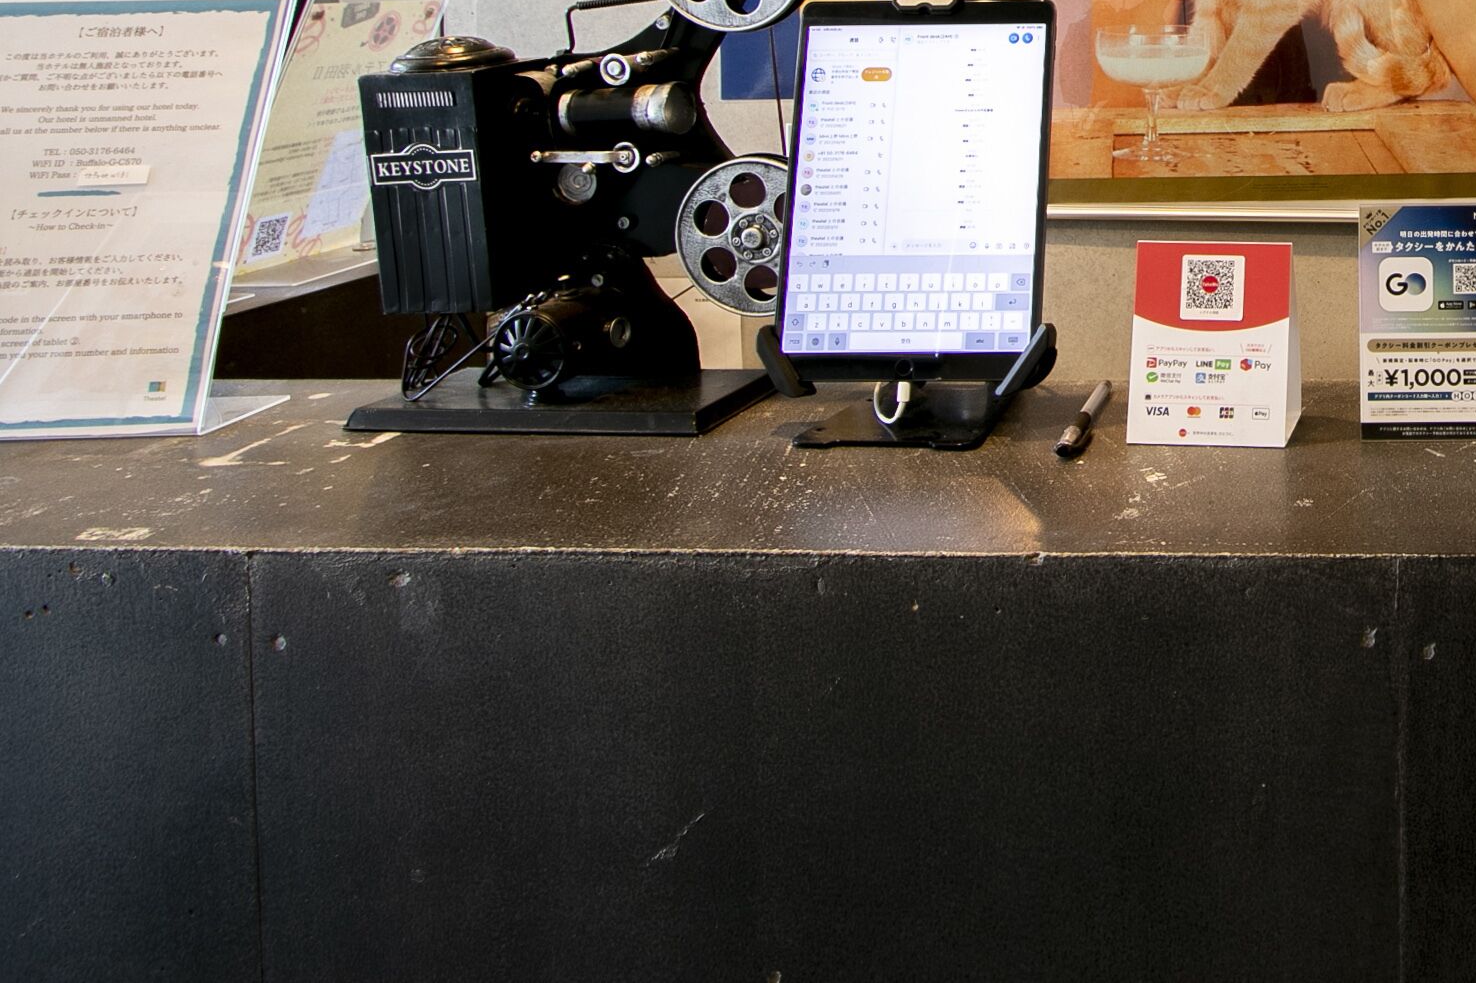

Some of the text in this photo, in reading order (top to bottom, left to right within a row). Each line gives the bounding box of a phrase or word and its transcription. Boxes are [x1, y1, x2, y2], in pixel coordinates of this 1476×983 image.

[16, 105, 53, 114] sincerely
[56, 104, 79, 112] thank
[80, 105, 97, 114] you
[98, 104, 110, 112] for
[112, 104, 134, 113] using
[152, 103, 173, 111] hotel
[175, 103, 199, 112] today.
[56, 115, 78, 123] hotel
[88, 115, 133, 123] unmanned
[34, 127, 48, 135] the
[50, 126, 82, 135] number
[84, 126, 109, 134] below
[119, 125, 140, 133] there
[151, 124, 187, 134] anything
[43, 148, 61, 156] TEL
[56, 159, 66, 167] ID
[377, 158, 471, 177] KEYSTONE
[51, 171, 71, 179] Pass
[32, 315, 46, 323] the
[48, 315, 77, 323] screen
[80, 314, 97, 322] with
[99, 314, 120, 323] your
[121, 312, 172, 321] smartphone
[32, 339, 43, 347] of
[43, 338, 68, 346] tablet
[27, 351, 48, 361] your
[75, 349, 109, 357] number
[110, 348, 127, 356] and
[129, 347, 179, 355] information
[1158, 360, 1272, 371] PayPay LINE Pay Pay
[1384, 369, 1462, 389] ¥1,000
[1146, 407, 1170, 416] VISA
